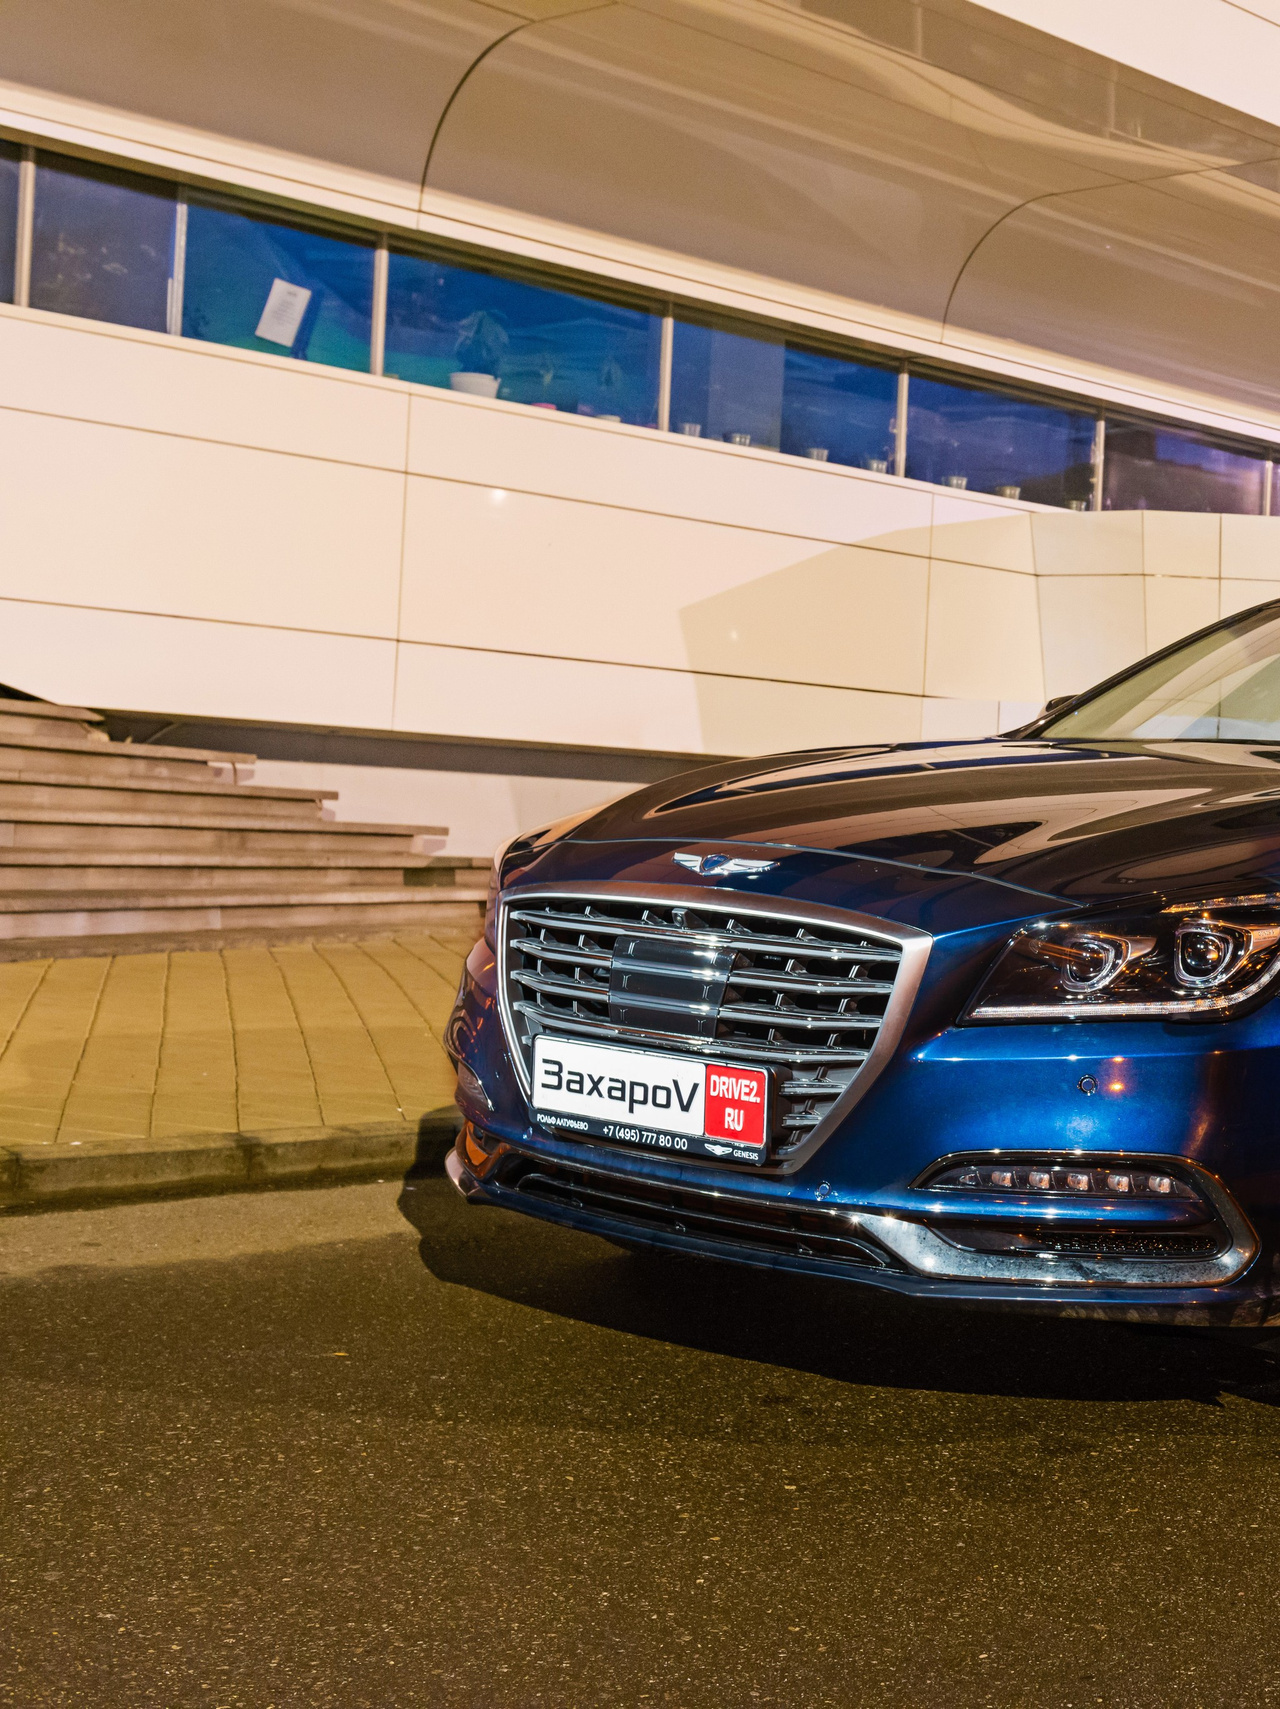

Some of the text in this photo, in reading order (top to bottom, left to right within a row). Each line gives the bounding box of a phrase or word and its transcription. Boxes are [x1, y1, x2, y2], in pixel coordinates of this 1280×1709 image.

[710, 1074, 760, 1103] DRIVE2.
[537, 1114, 588, 1130] РОЛЬФ АЛТУФЬЕВО
[724, 1107, 744, 1131] RU
[603, 1125, 688, 1150] +7 (495) 777 80 00
[733, 1149, 759, 1160] GENESIS
